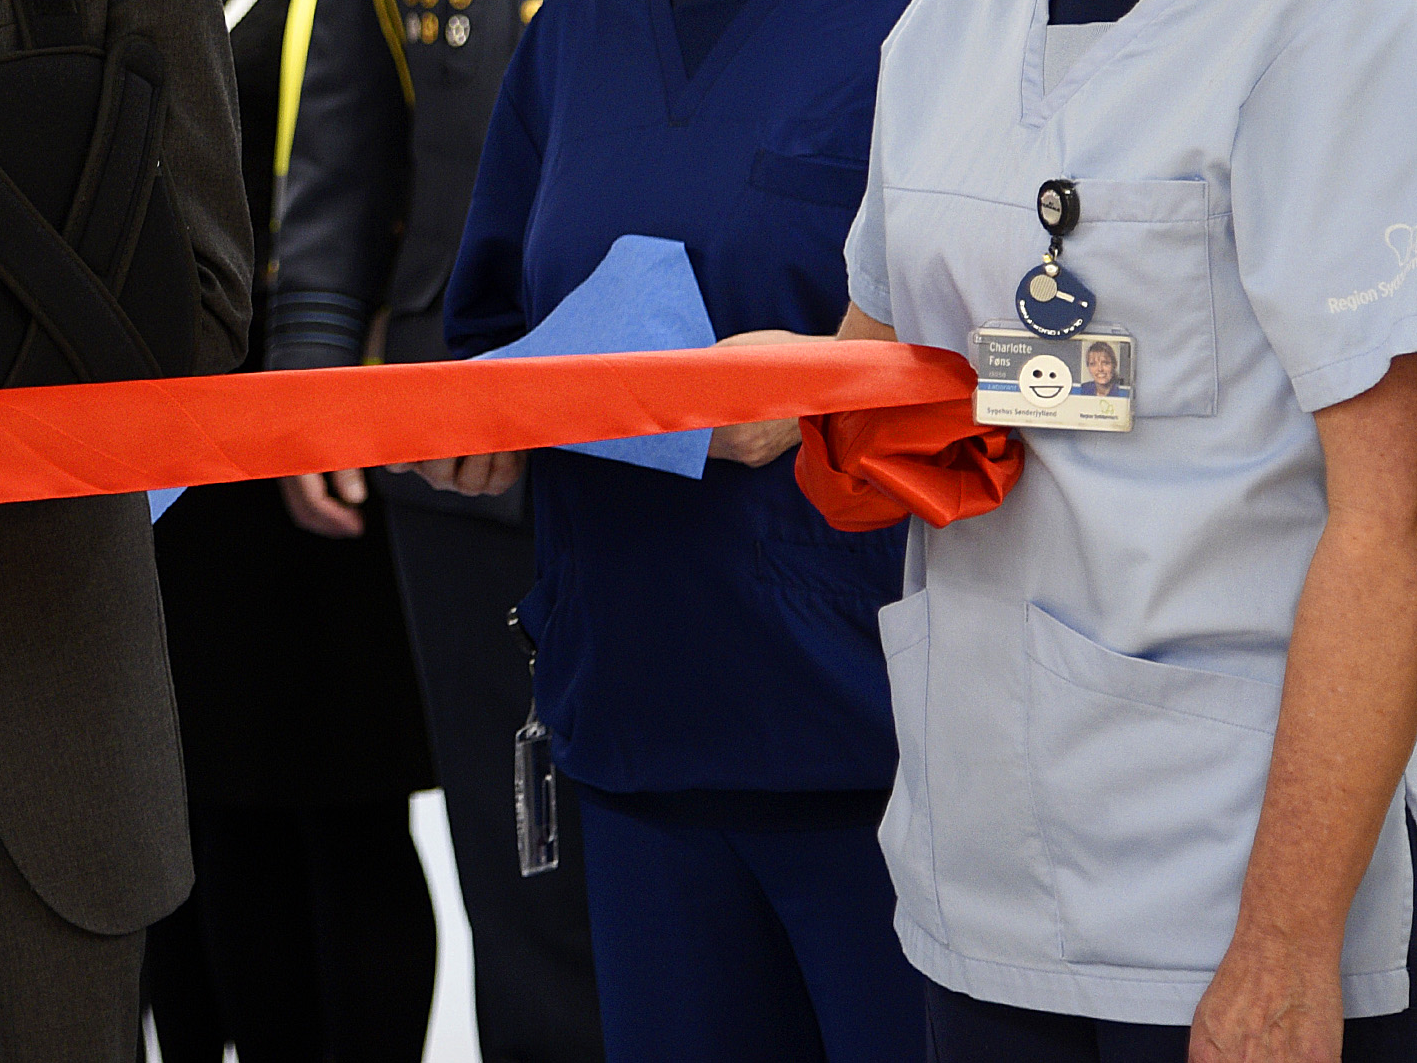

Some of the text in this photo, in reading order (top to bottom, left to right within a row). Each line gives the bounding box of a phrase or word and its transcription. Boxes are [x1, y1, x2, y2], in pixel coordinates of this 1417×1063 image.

[1327, 289, 1379, 314] Region
[989, 342, 1032, 354] Charlotte
[989, 355, 1011, 367] Føns
